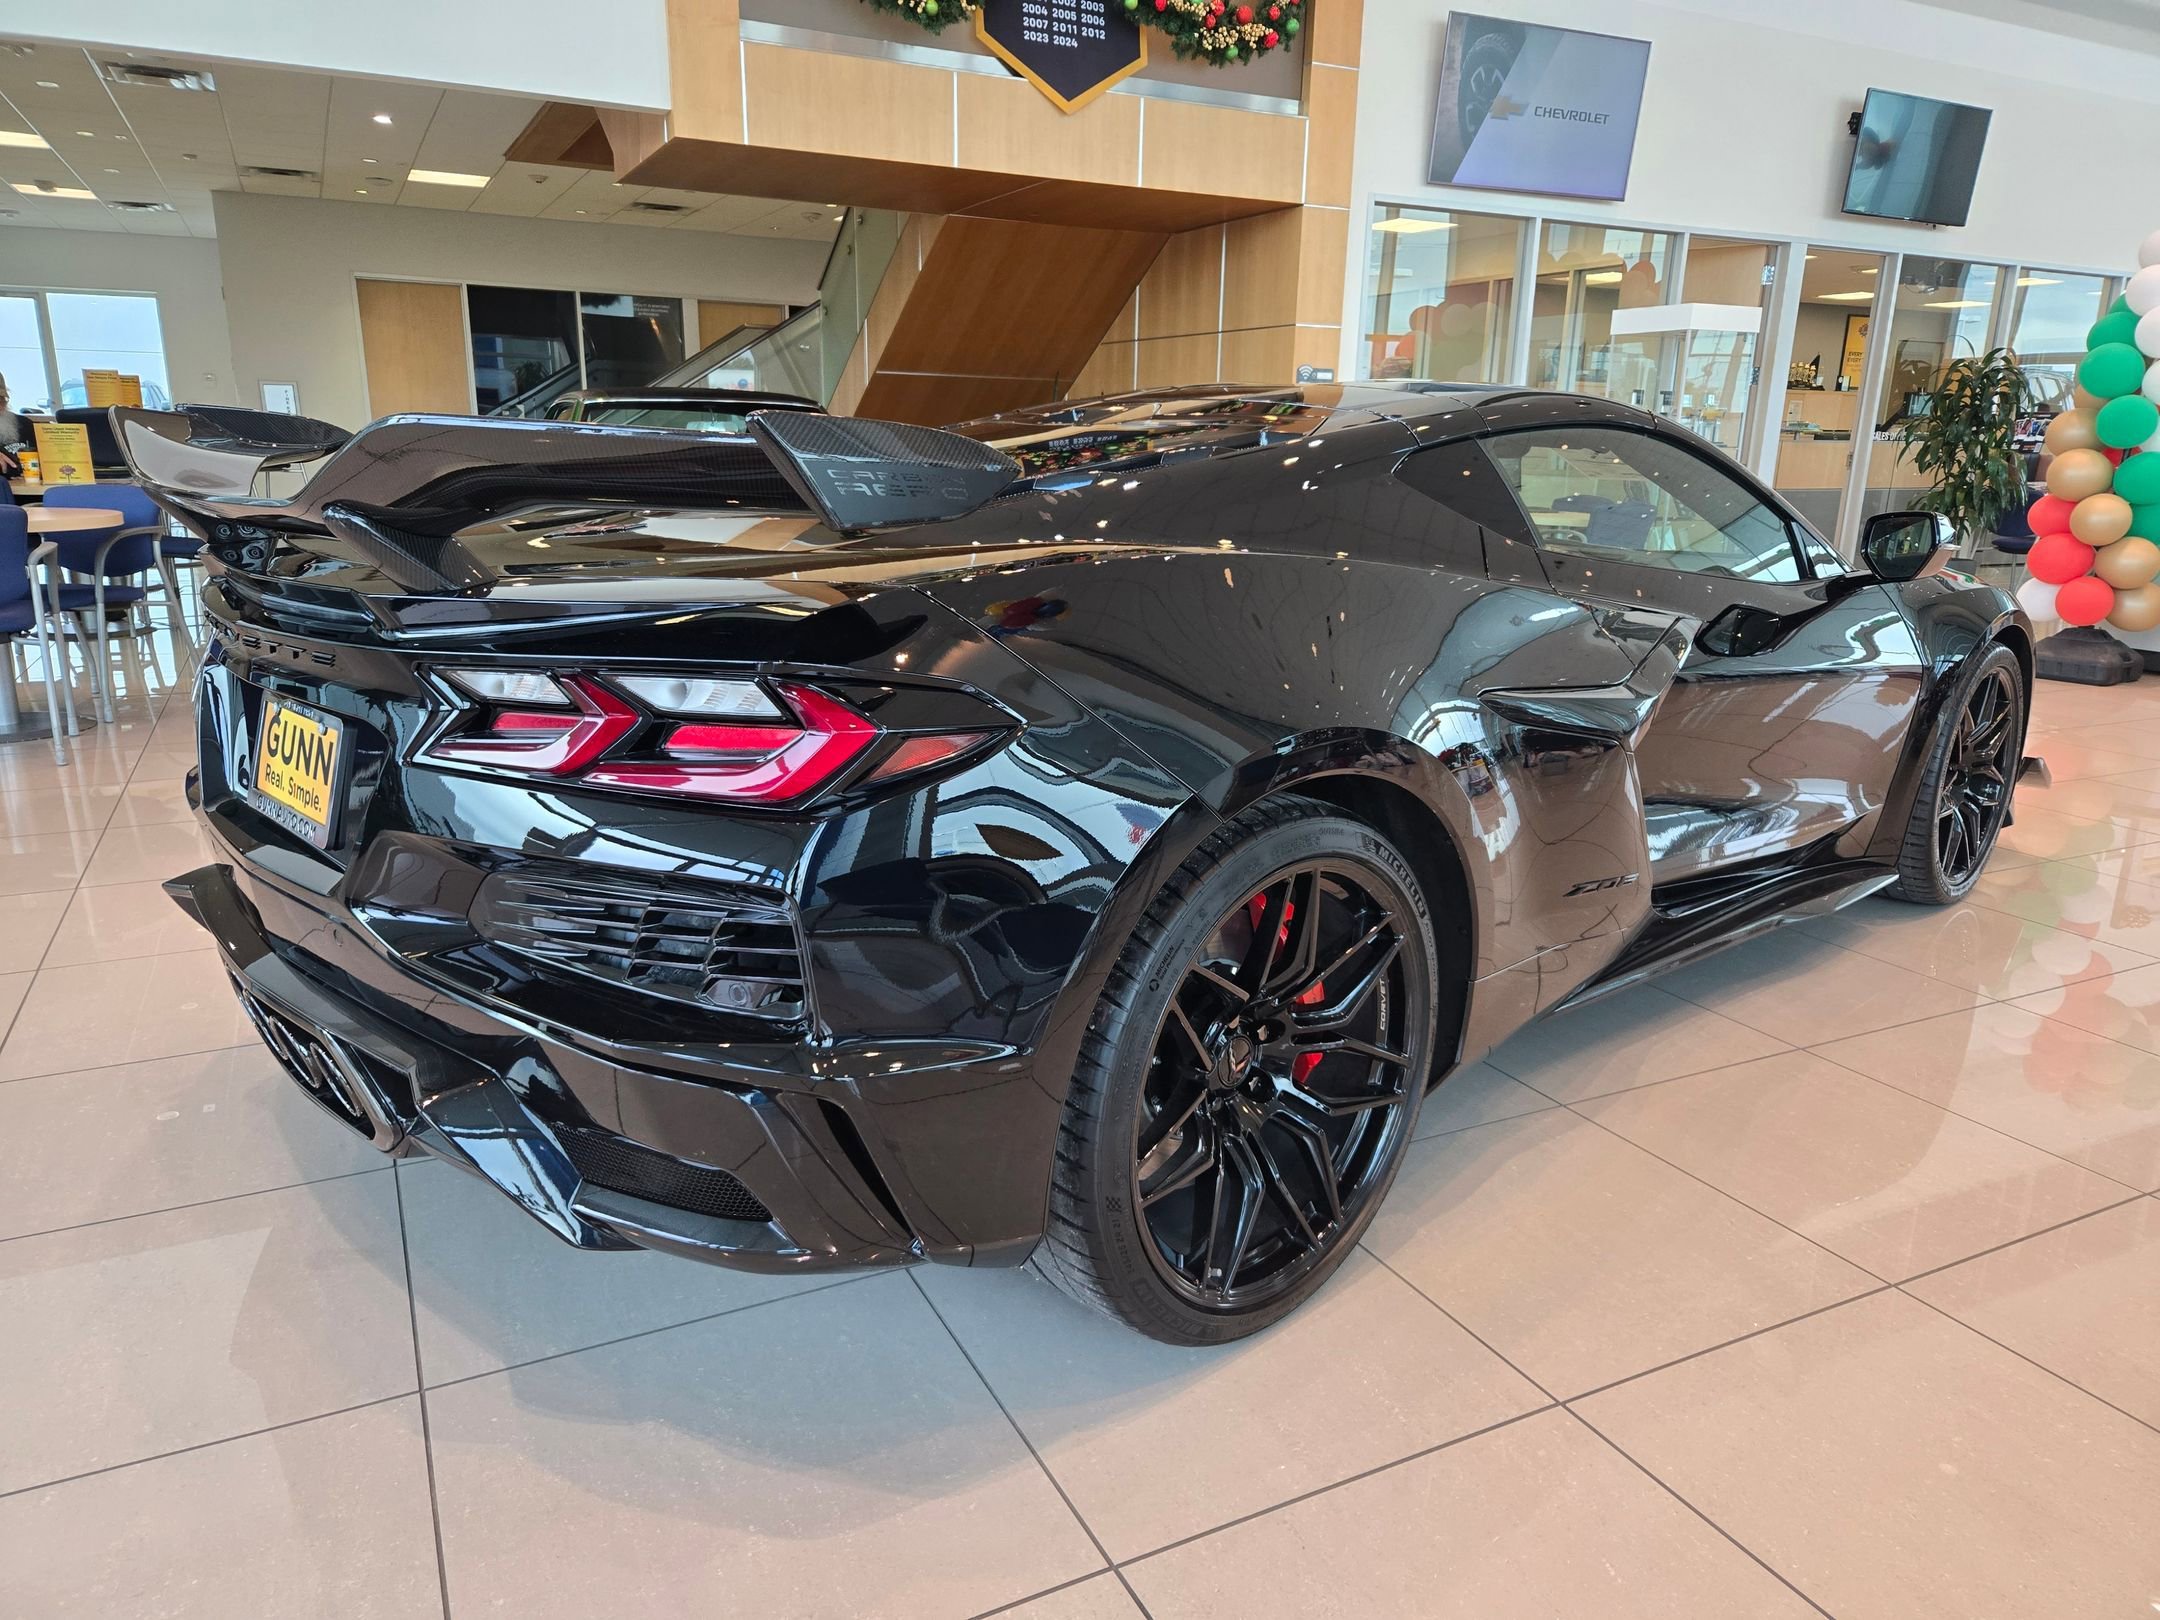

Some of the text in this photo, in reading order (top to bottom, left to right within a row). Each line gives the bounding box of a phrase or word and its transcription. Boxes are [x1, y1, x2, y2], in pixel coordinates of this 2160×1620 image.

[1022, 3, 1105, 26] 2004 2005 2006
[1081, 0, 1105, 13] 2003
[1023, 17, 1106, 40] 2007 2011 2012
[1023, 30, 1078, 48] 2023 2024
[1534, 106, 1610, 125] CHEVROLET
[267, 714, 334, 786] GUNN
[265, 763, 322, 813] Real. Simple.
[257, 795, 317, 841] GUNNAUTO.COM
[1378, 845, 1426, 913] MICHELIN
[1155, 944, 1175, 978] MICHELIN
